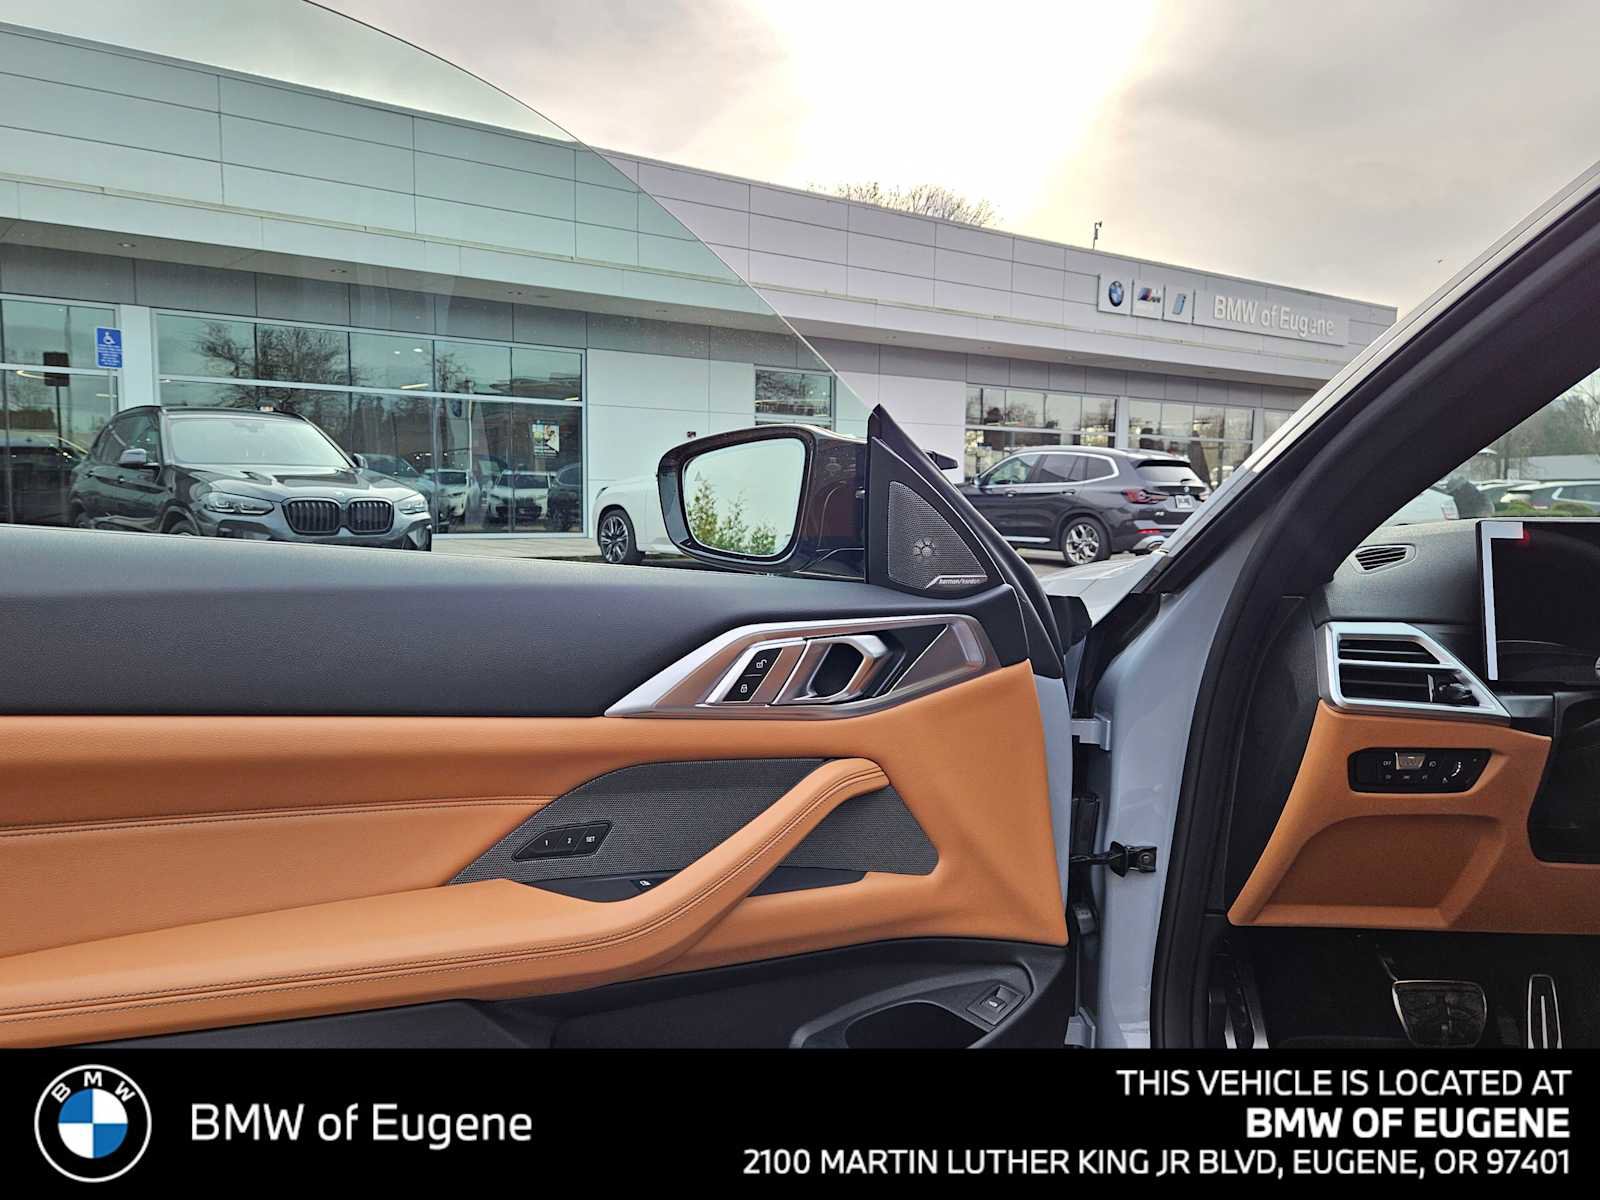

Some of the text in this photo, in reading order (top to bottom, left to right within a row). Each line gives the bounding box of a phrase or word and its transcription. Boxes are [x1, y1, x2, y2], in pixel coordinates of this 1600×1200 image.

[1213, 295, 1336, 337] BMW of Eugene
